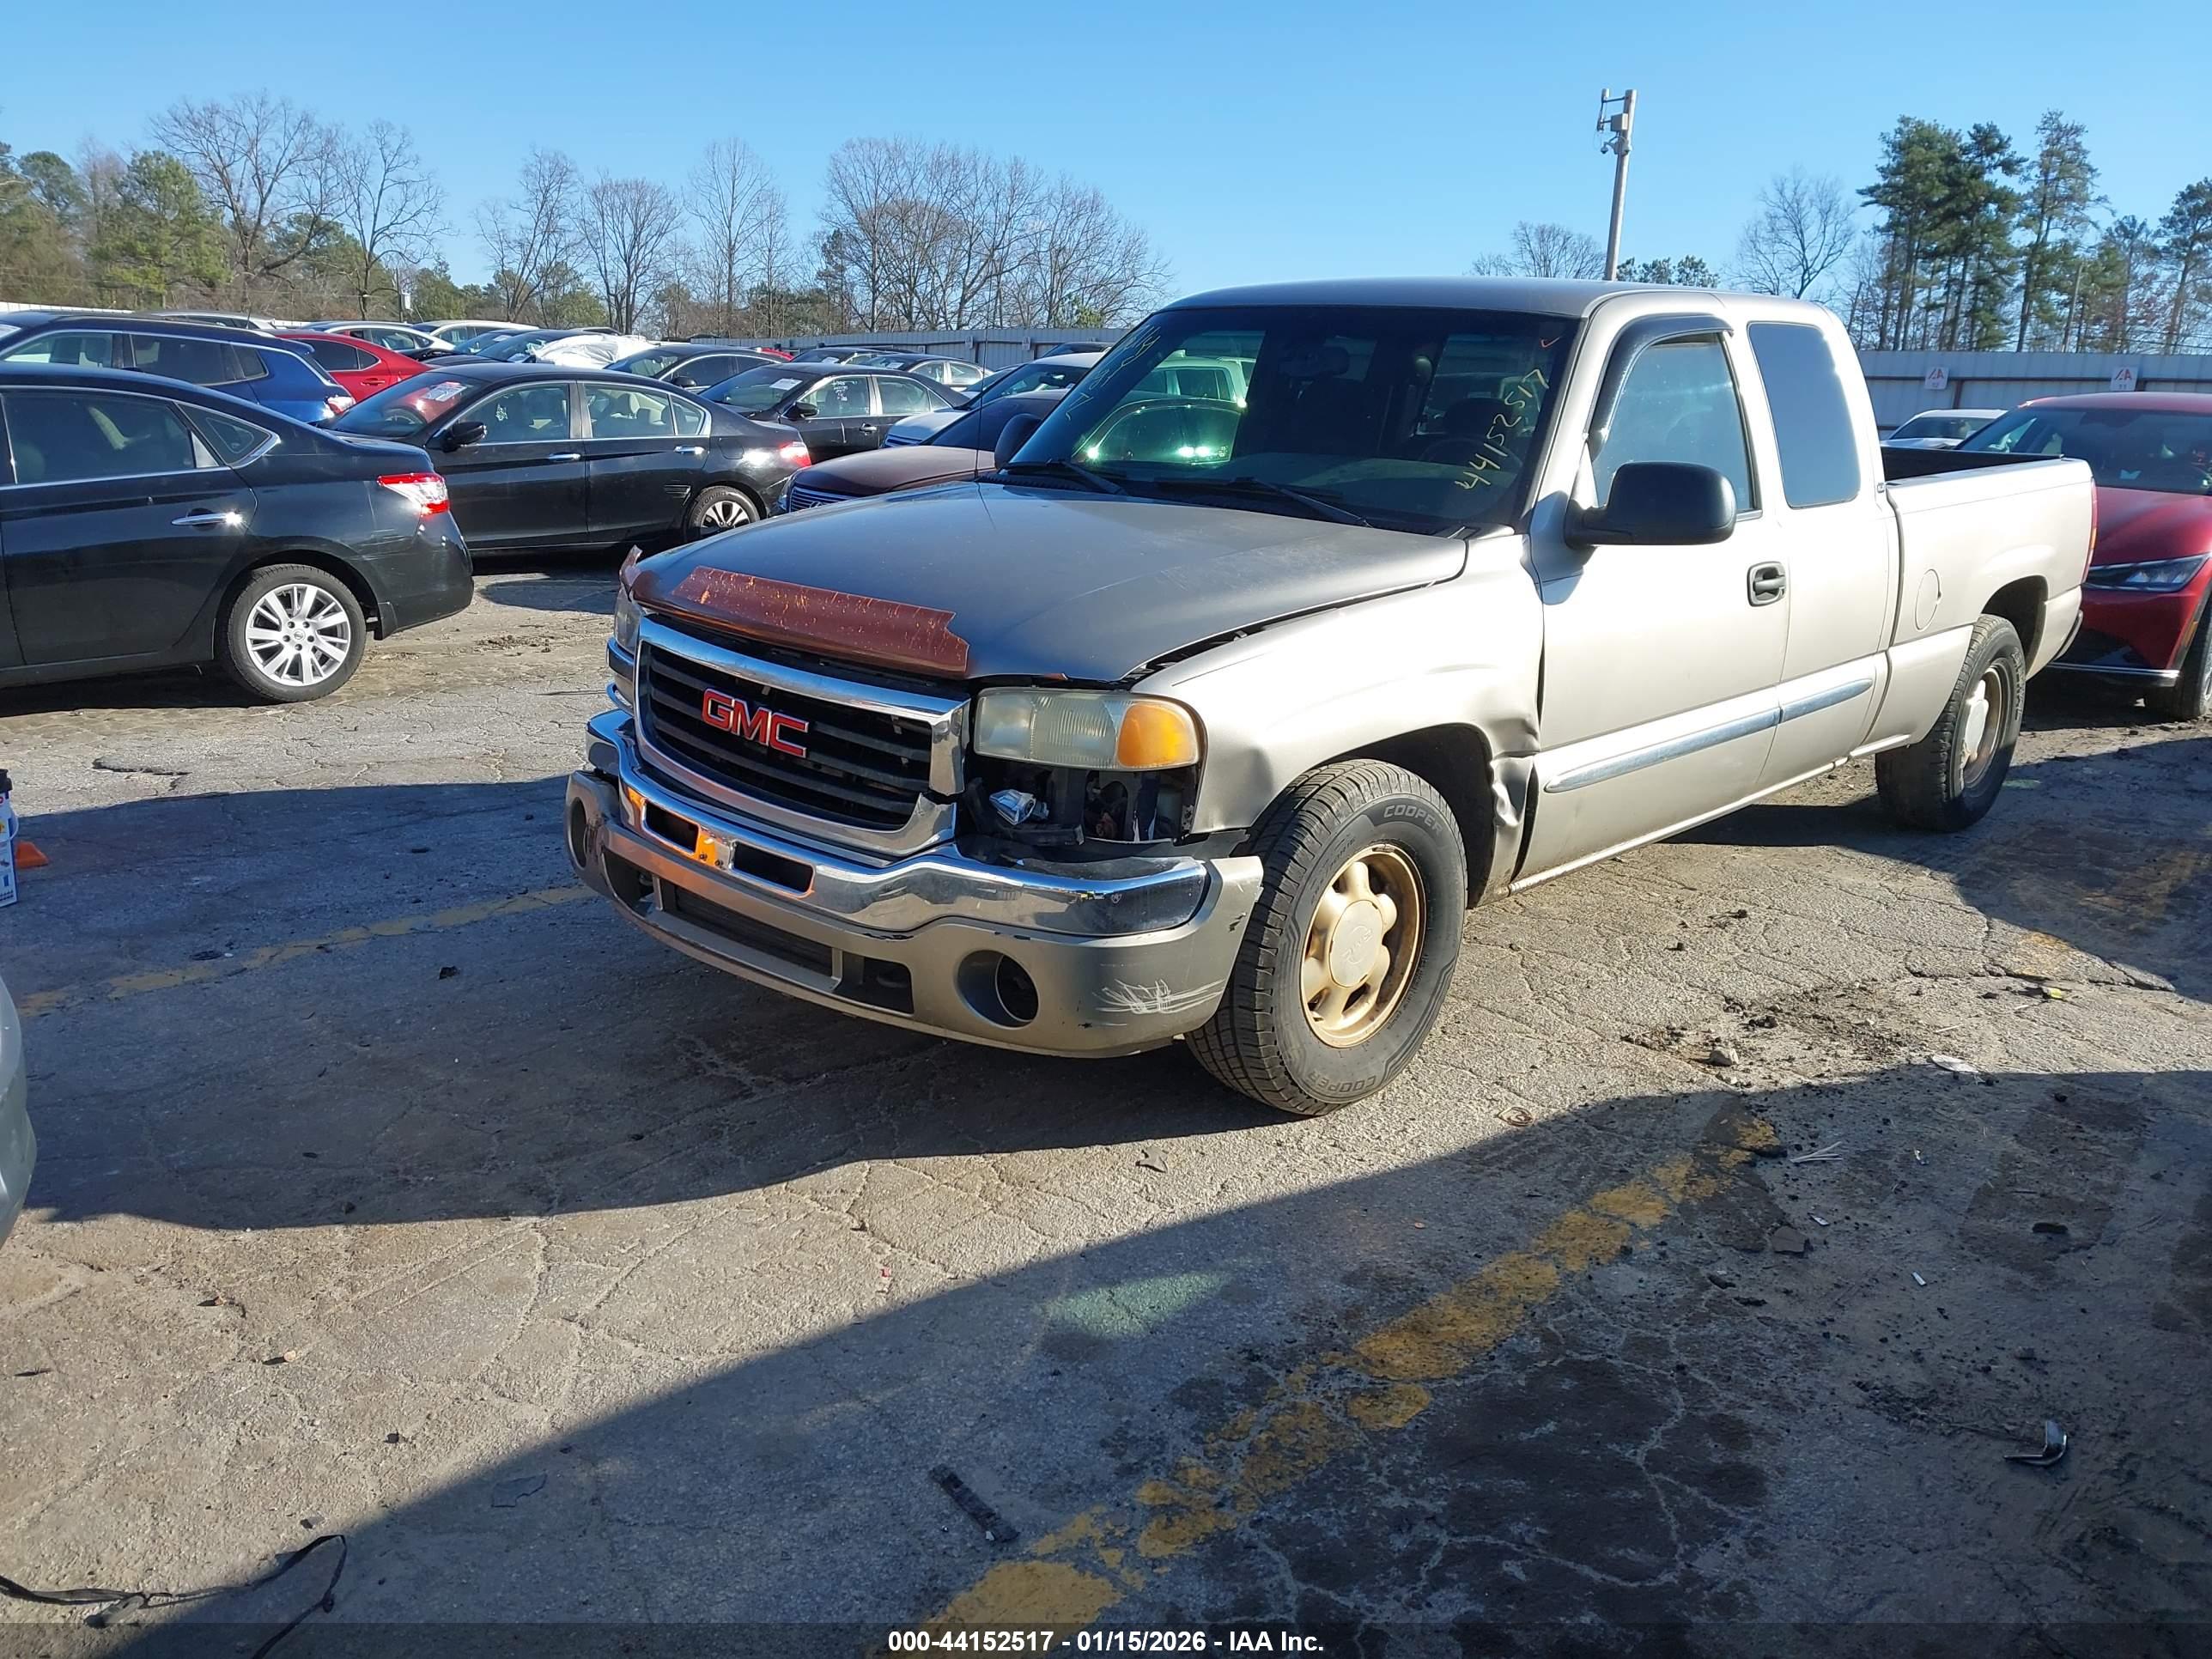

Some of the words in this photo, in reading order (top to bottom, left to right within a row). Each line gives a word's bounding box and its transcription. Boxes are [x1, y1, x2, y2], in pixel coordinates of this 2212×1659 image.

[1455, 369, 1550, 489] 44152517
[702, 688, 810, 758] GMC
[1382, 804, 1443, 836] COOPER
[1307, 1069, 1376, 1093] COOPER
